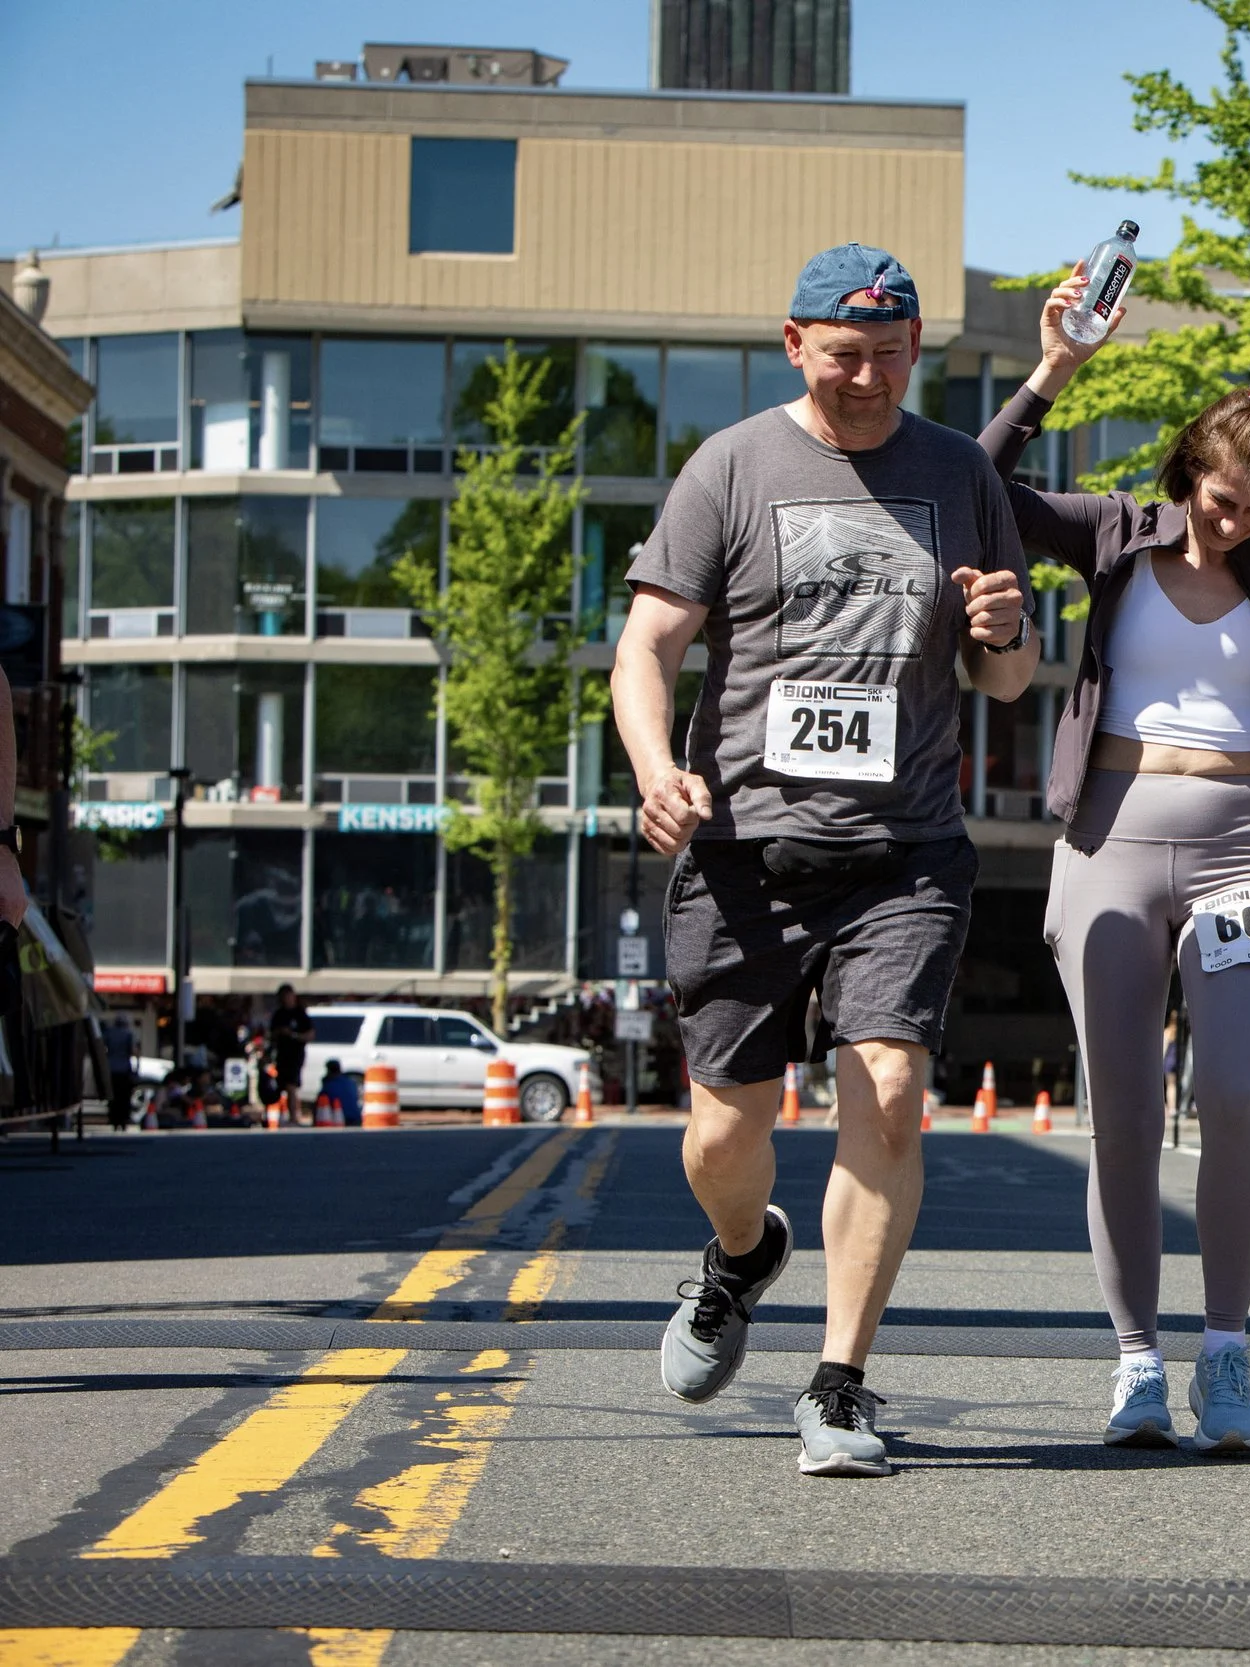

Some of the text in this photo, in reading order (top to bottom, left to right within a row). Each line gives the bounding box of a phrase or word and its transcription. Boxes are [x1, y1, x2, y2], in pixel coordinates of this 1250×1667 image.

[1104, 263, 1127, 303] essentia
[793, 578, 927, 599] O'NEILL
[783, 684, 868, 702] BIONIC
[790, 707, 872, 754] 254
[1210, 958, 1233, 970] FOOD
